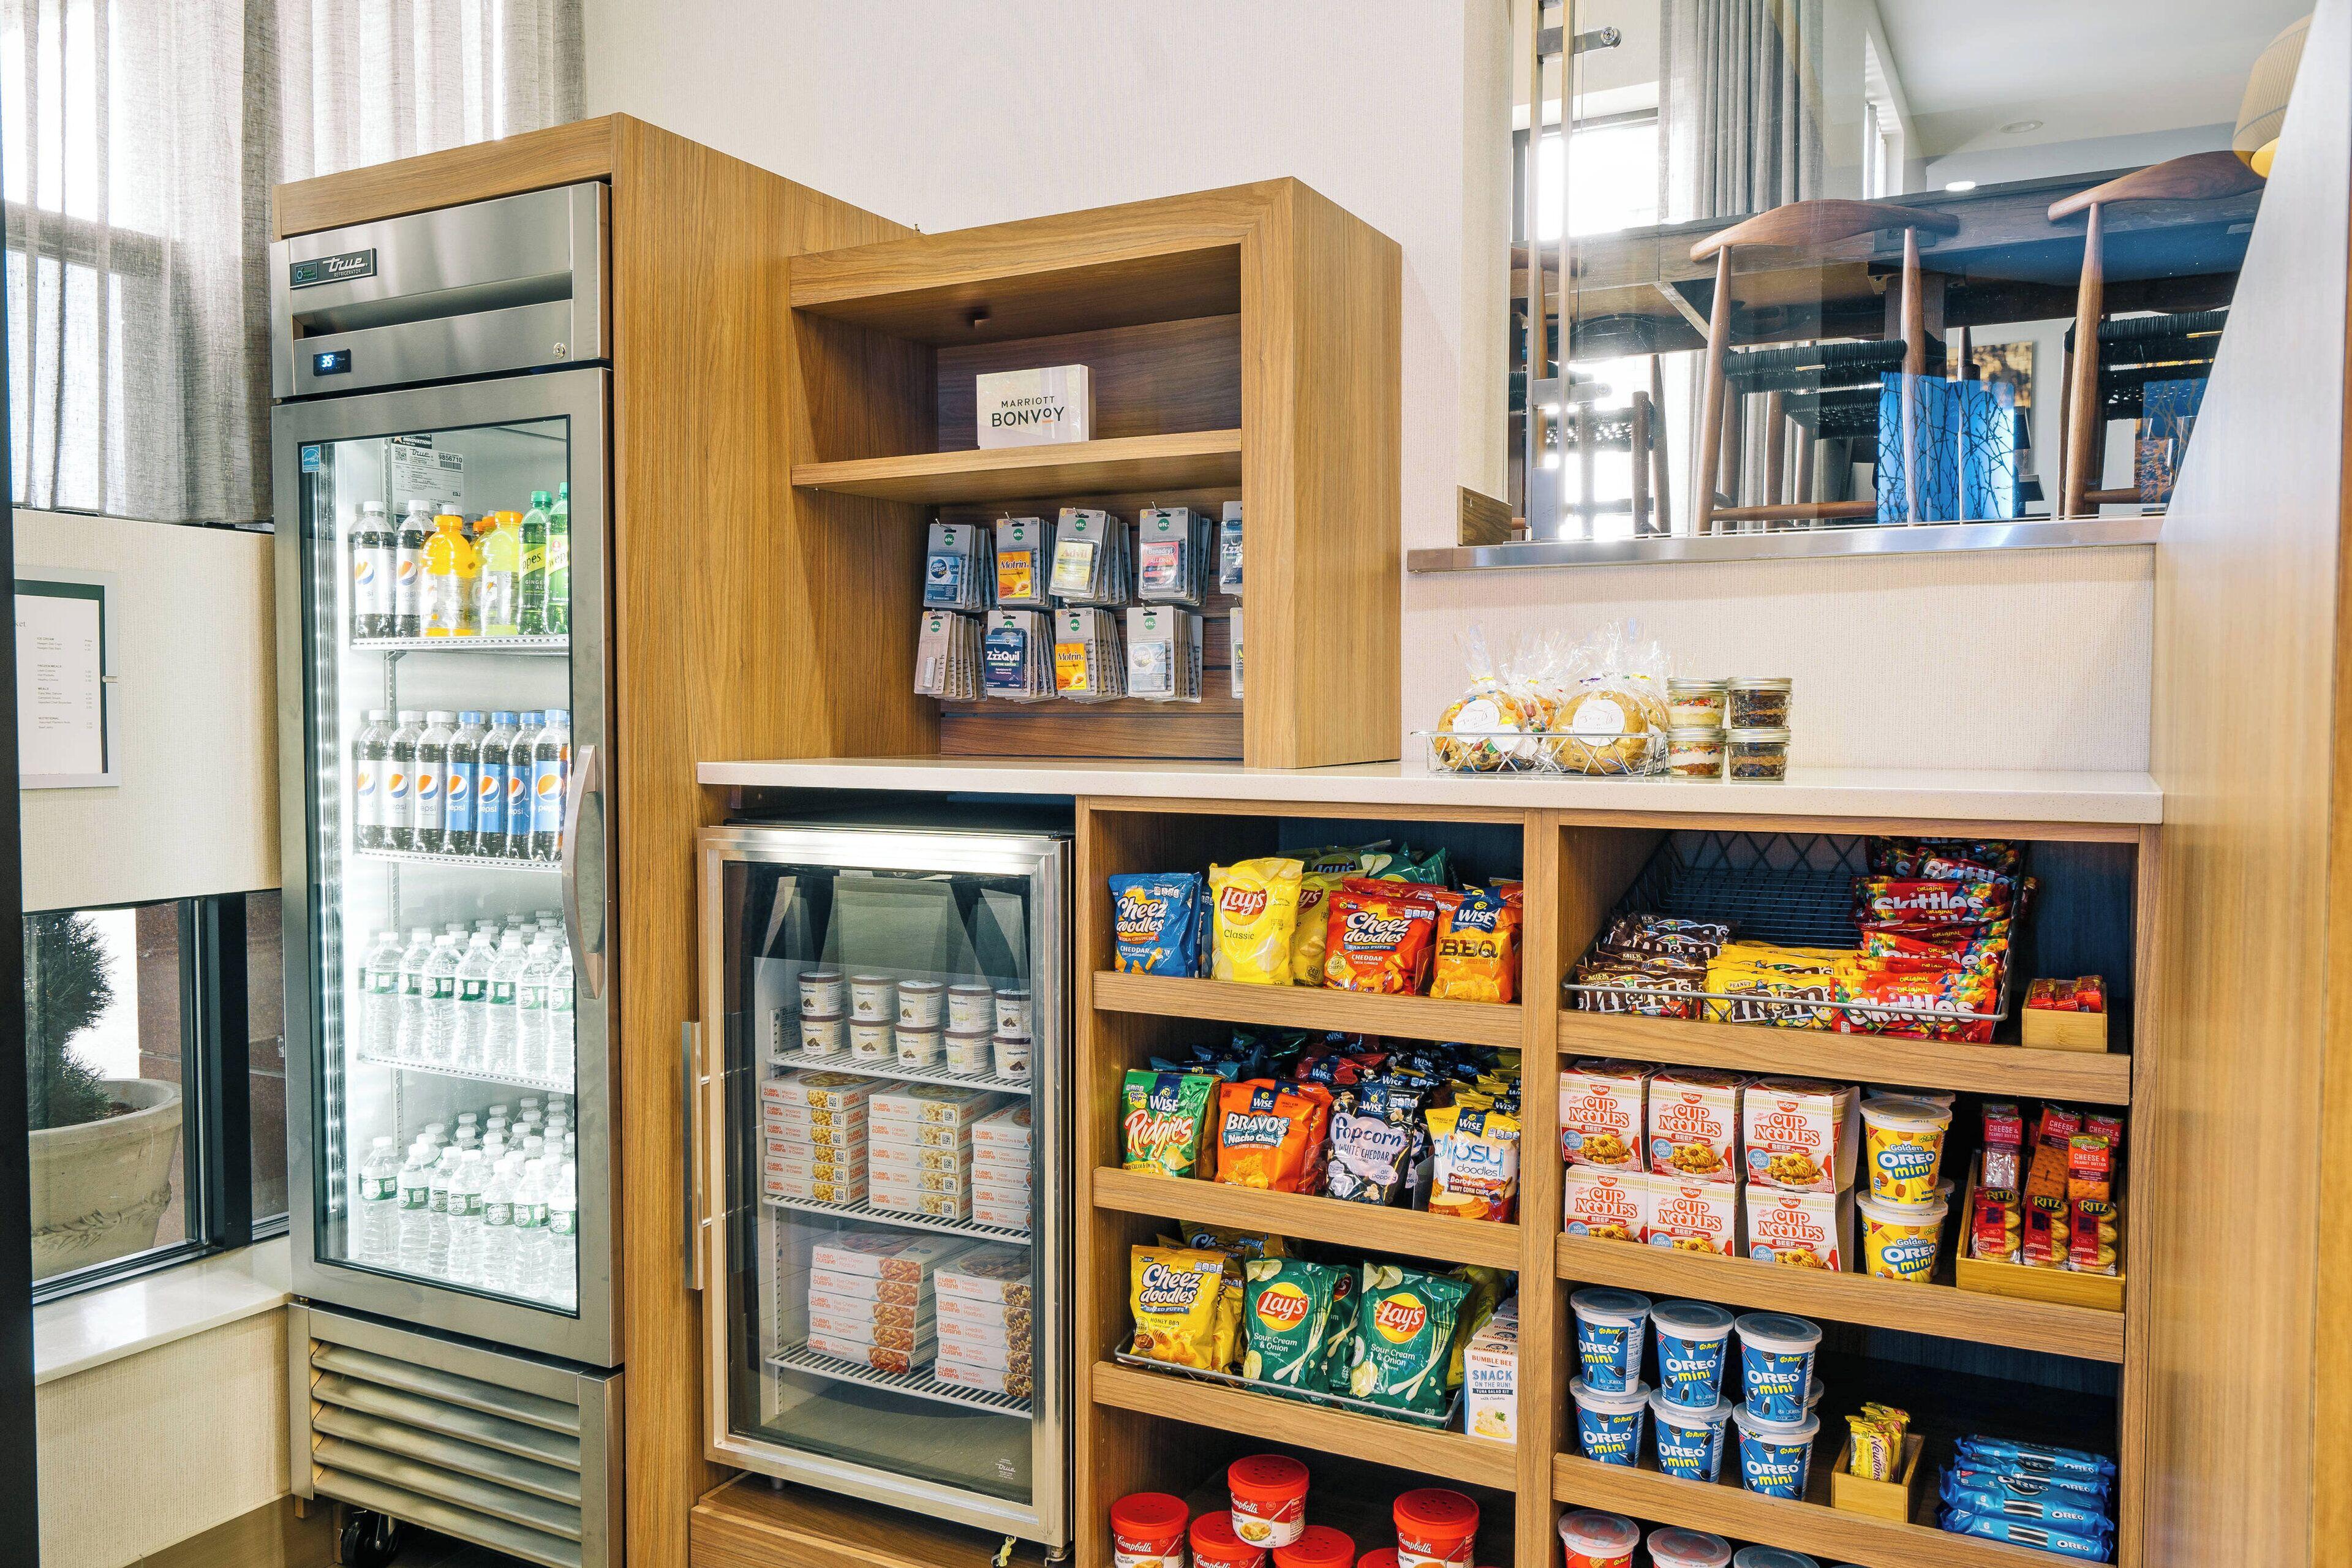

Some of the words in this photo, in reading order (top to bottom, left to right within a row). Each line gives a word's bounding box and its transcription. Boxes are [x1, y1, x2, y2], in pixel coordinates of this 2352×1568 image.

[1001, 396, 1055, 408] MARRIOTT
[992, 406, 1065, 427] BONVOY
[1000, 560, 1027, 569] Motrin
[986, 650, 1020, 662] ZzzQuil
[1057, 652, 1082, 661] Motrin
[1222, 886, 1265, 915] Lay's
[1874, 891, 1985, 910] Skittles
[1347, 911, 1412, 933] Cheez
[1458, 909, 1493, 924] WISE
[1224, 929, 1254, 940] Classic
[1343, 930, 1406, 944] doodles
[1120, 945, 1150, 954] CHEDDAR
[1439, 938, 1498, 958] BBQ
[1848, 993, 1975, 1025] Skittles
[1312, 1068, 1332, 1080] WISE
[1150, 1095, 1178, 1112] WISE
[1253, 1098, 1273, 1107] WISE
[1363, 1101, 1384, 1112] WISE
[1584, 1096, 1618, 1112] CUP
[1569, 1107, 1630, 1128] NOODLES
[1673, 1104, 1709, 1120] CUP
[1459, 1118, 1482, 1131] WISE
[1658, 1114, 1722, 1137] NOODLES
[1769, 1113, 1807, 1130] CUP
[1125, 1109, 1193, 1159] Ridgies
[1336, 1117, 1402, 1147] Popcorn
[1754, 1124, 1820, 1146] NOODLES
[1989, 1125, 2013, 1134] CHEESE
[1228, 1134, 1254, 1144] Nacho
[1339, 1144, 1359, 1156] WHITE
[1360, 1148, 1390, 1161] CHEDDAR
[1890, 1144, 1923, 1152] Golden
[1879, 1152, 1936, 1167] OREO
[2074, 1152, 2099, 1162] CHEESE
[1456, 1164, 1498, 1177] doodles
[1894, 1164, 1930, 1178] mini
[2032, 1195, 2062, 1210] RITZ
[2079, 1200, 2109, 1214] RITZ
[1896, 1238, 1928, 1246] Golden
[1883, 1245, 1936, 1262] OREO
[1901, 1257, 1932, 1273] mini
[1142, 1263, 1204, 1289] Cheez
[1139, 1287, 1198, 1304] doodles
[1259, 1291, 1305, 1321] Lay's
[1378, 1302, 1424, 1332] Lay's
[1254, 1332, 1272, 1342] Sour
[1273, 1337, 1297, 1346] Cream
[1265, 1343, 1289, 1352] Onion
[1371, 1343, 1390, 1354] Sour
[1390, 1349, 1416, 1360] Cream
[1578, 1340, 1619, 1355] OREO
[1382, 1355, 1406, 1366] Onion
[1472, 1354, 1499, 1365] BUMBLE
[1585, 1353, 1613, 1365] mini
[1665, 1359, 1716, 1372] OREO
[1472, 1370, 1513, 1381] SNACK
[1678, 1368, 1711, 1382] mini
[1747, 1370, 1800, 1384] OREO
[1759, 1381, 1793, 1395] mini
[1583, 1431, 1632, 1444] OREO
[1594, 1441, 1626, 1455] mini
[1658, 1442, 1706, 1458] OREO
[1667, 1455, 1700, 1468] mini
[1869, 1435, 1883, 1481] Newtons
[1746, 1460, 1800, 1476] OREO
[1758, 1472, 1793, 1487] mini
[2051, 1510, 2084, 1521] OREO
[1117, 1535, 1152, 1553] Campbell's
[1398, 1531, 1432, 1555] Campbell's
[2057, 1539, 2089, 1551] OREO
